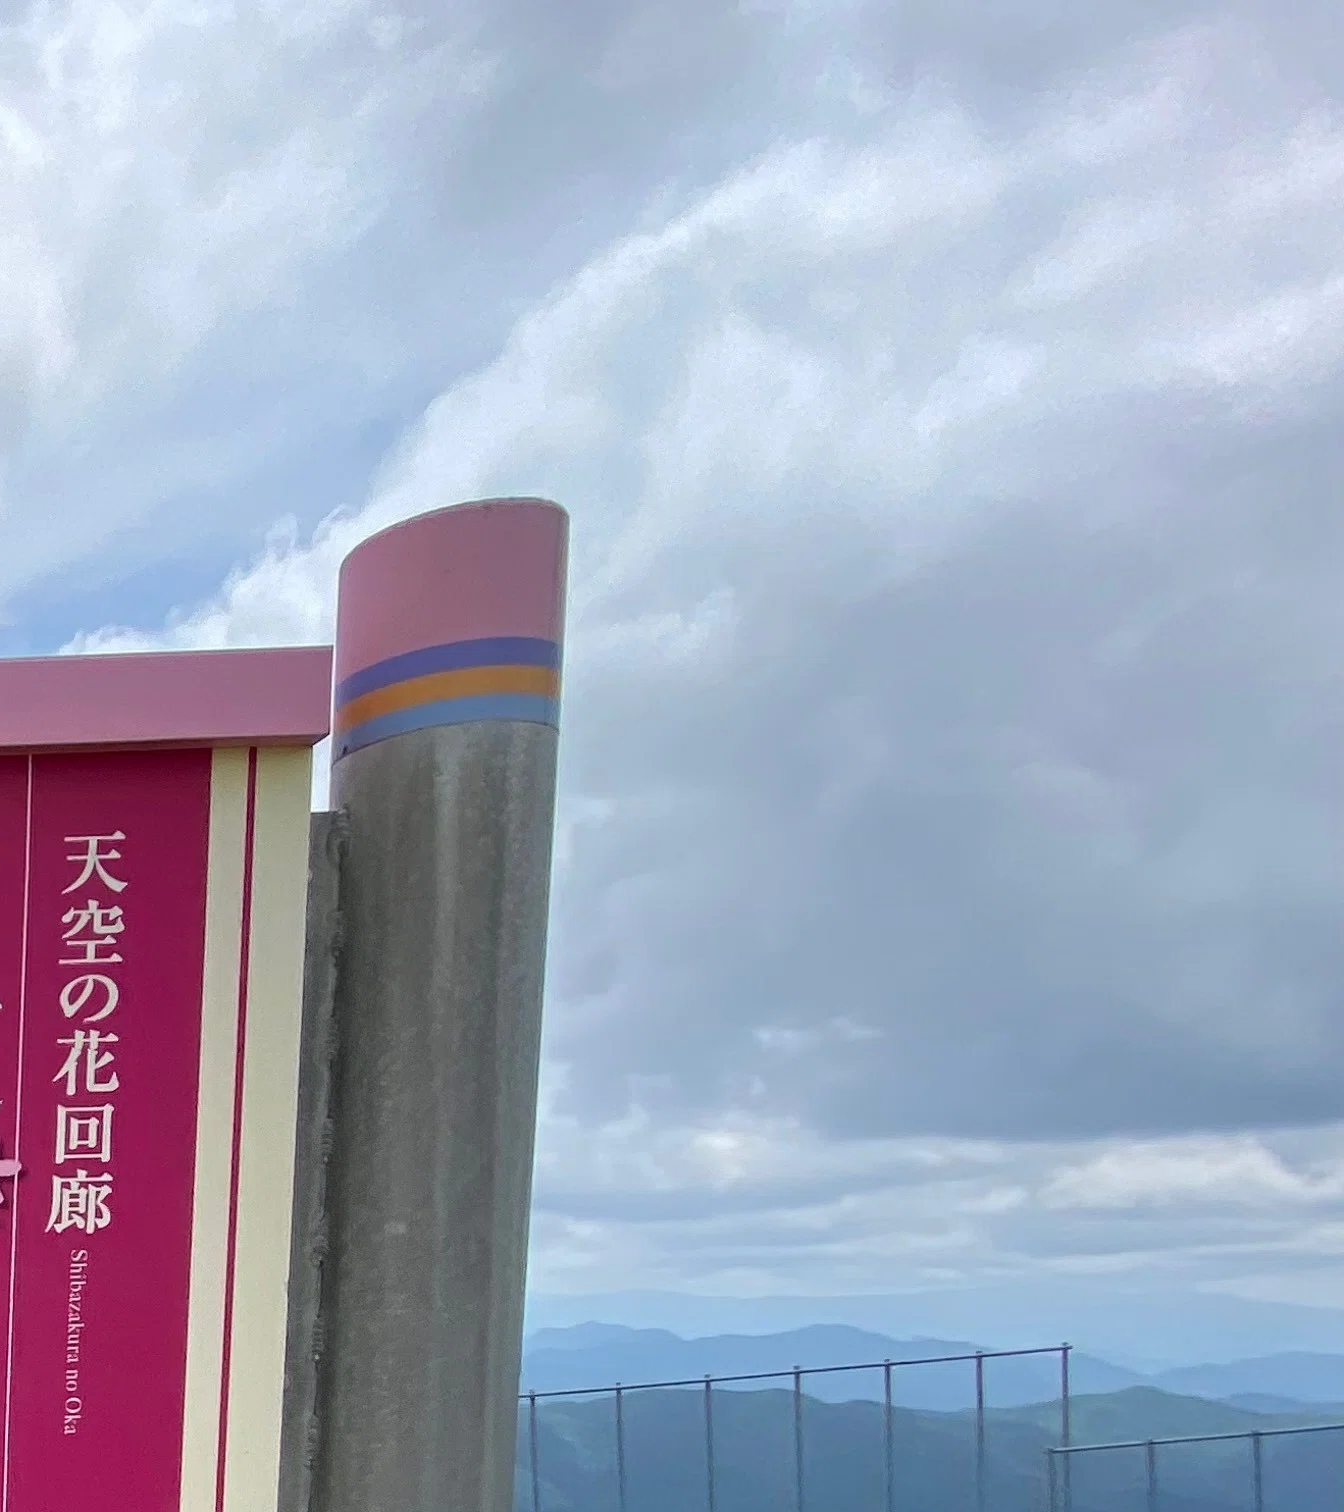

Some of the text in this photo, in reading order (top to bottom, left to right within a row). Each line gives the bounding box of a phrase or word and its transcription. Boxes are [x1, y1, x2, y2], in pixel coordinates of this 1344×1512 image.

[45, 830, 129, 1235] 天空の花回廊
[63, 1249, 89, 1436] Shibazakura no Oka
